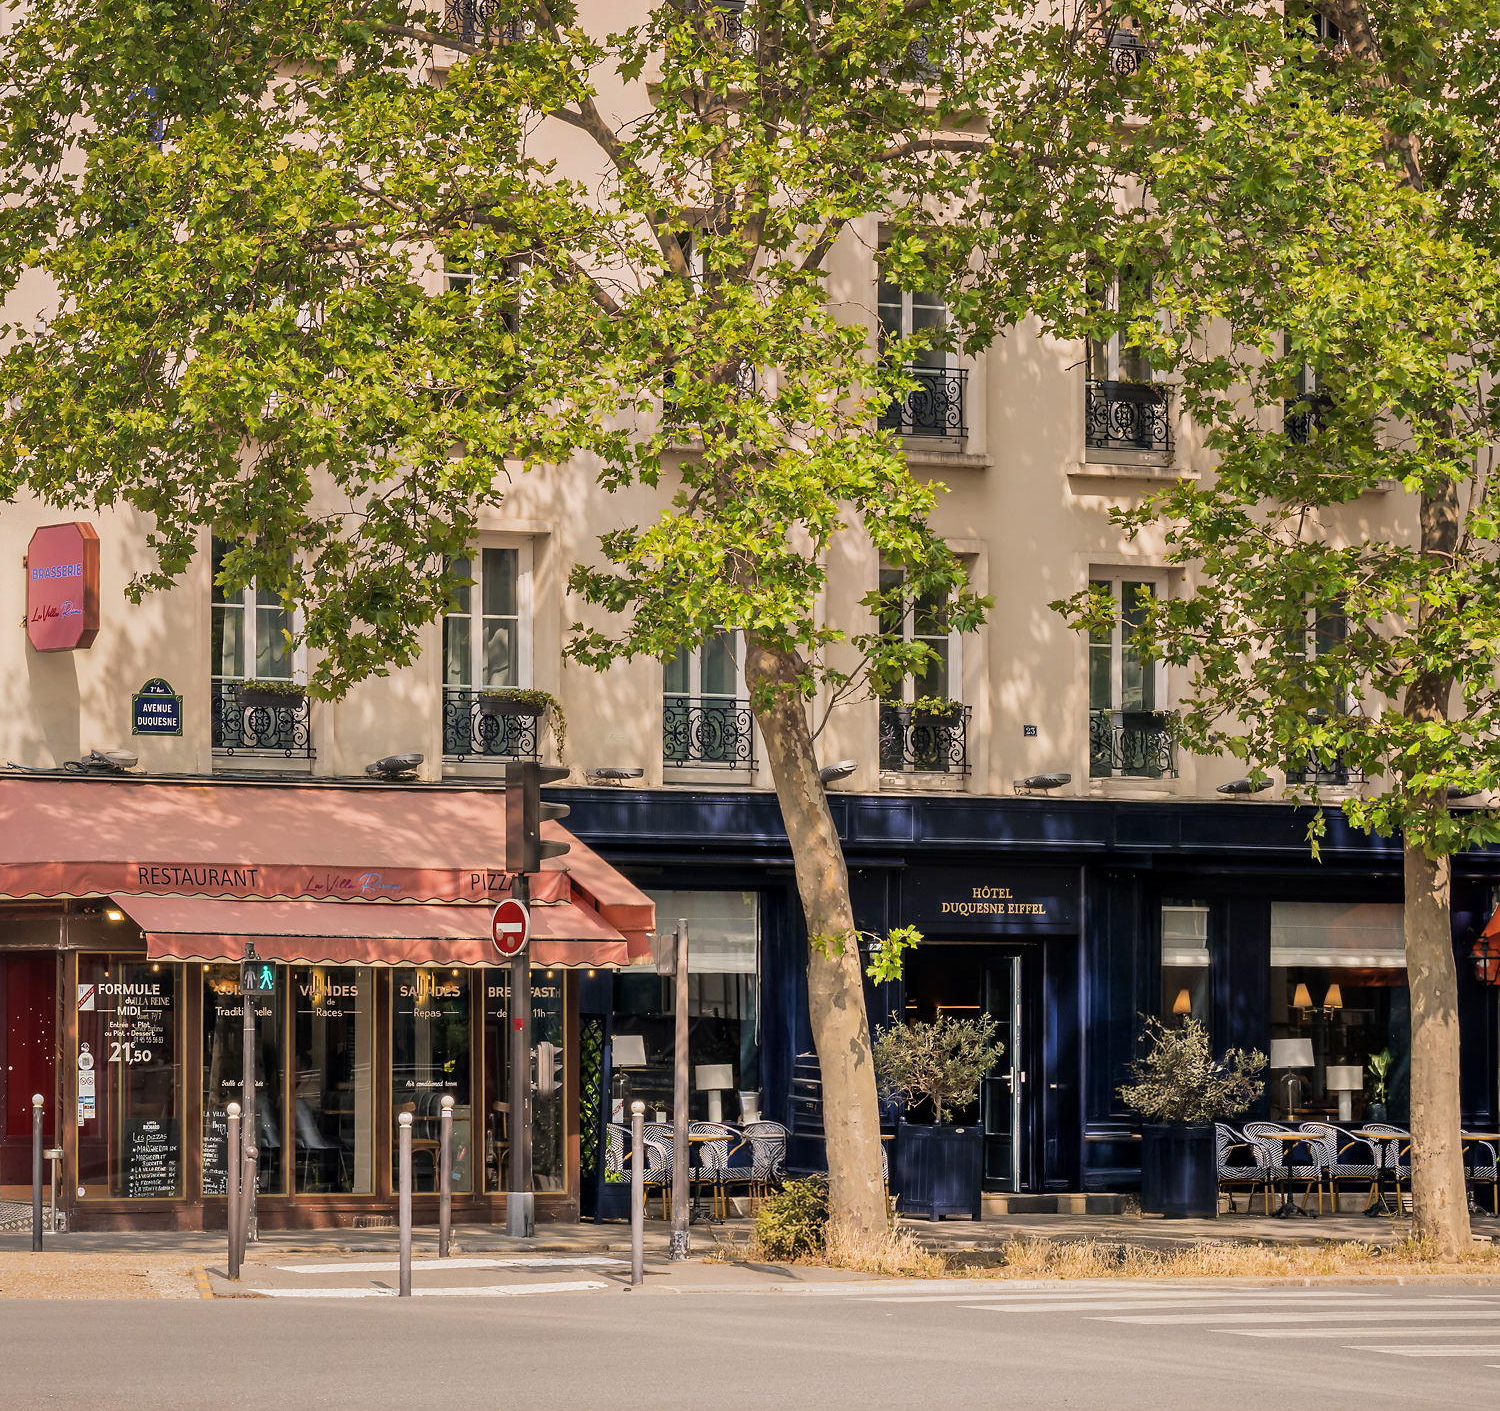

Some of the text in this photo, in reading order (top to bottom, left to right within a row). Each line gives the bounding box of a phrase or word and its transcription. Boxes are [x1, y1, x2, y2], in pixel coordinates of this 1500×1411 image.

[32, 563, 82, 580] BRASSERIE
[142, 703, 172, 713] AVENUE
[137, 716, 177, 726] DUQUESNE
[138, 867, 258, 887] RESTAURANT
[303, 875, 324, 892] La
[326, 874, 356, 893] Villa
[972, 885, 1013, 899] HÔTEL
[941, 902, 1046, 917] DUQUESNE EIFFEL
[98, 983, 160, 995] FORMULE
[300, 985, 359, 997] VIANDES
[400, 985, 461, 998] SALADES
[488, 986, 556, 998] BREFAST
[150, 996, 170, 1006] REINE
[117, 1006, 140, 1015] MIDI
[215, 1006, 273, 1017] Traditinelle
[316, 1007, 343, 1017] Races
[413, 1008, 442, 1020] Repas
[496, 1008, 508, 1018] de
[533, 1008, 546, 1018] 11h
